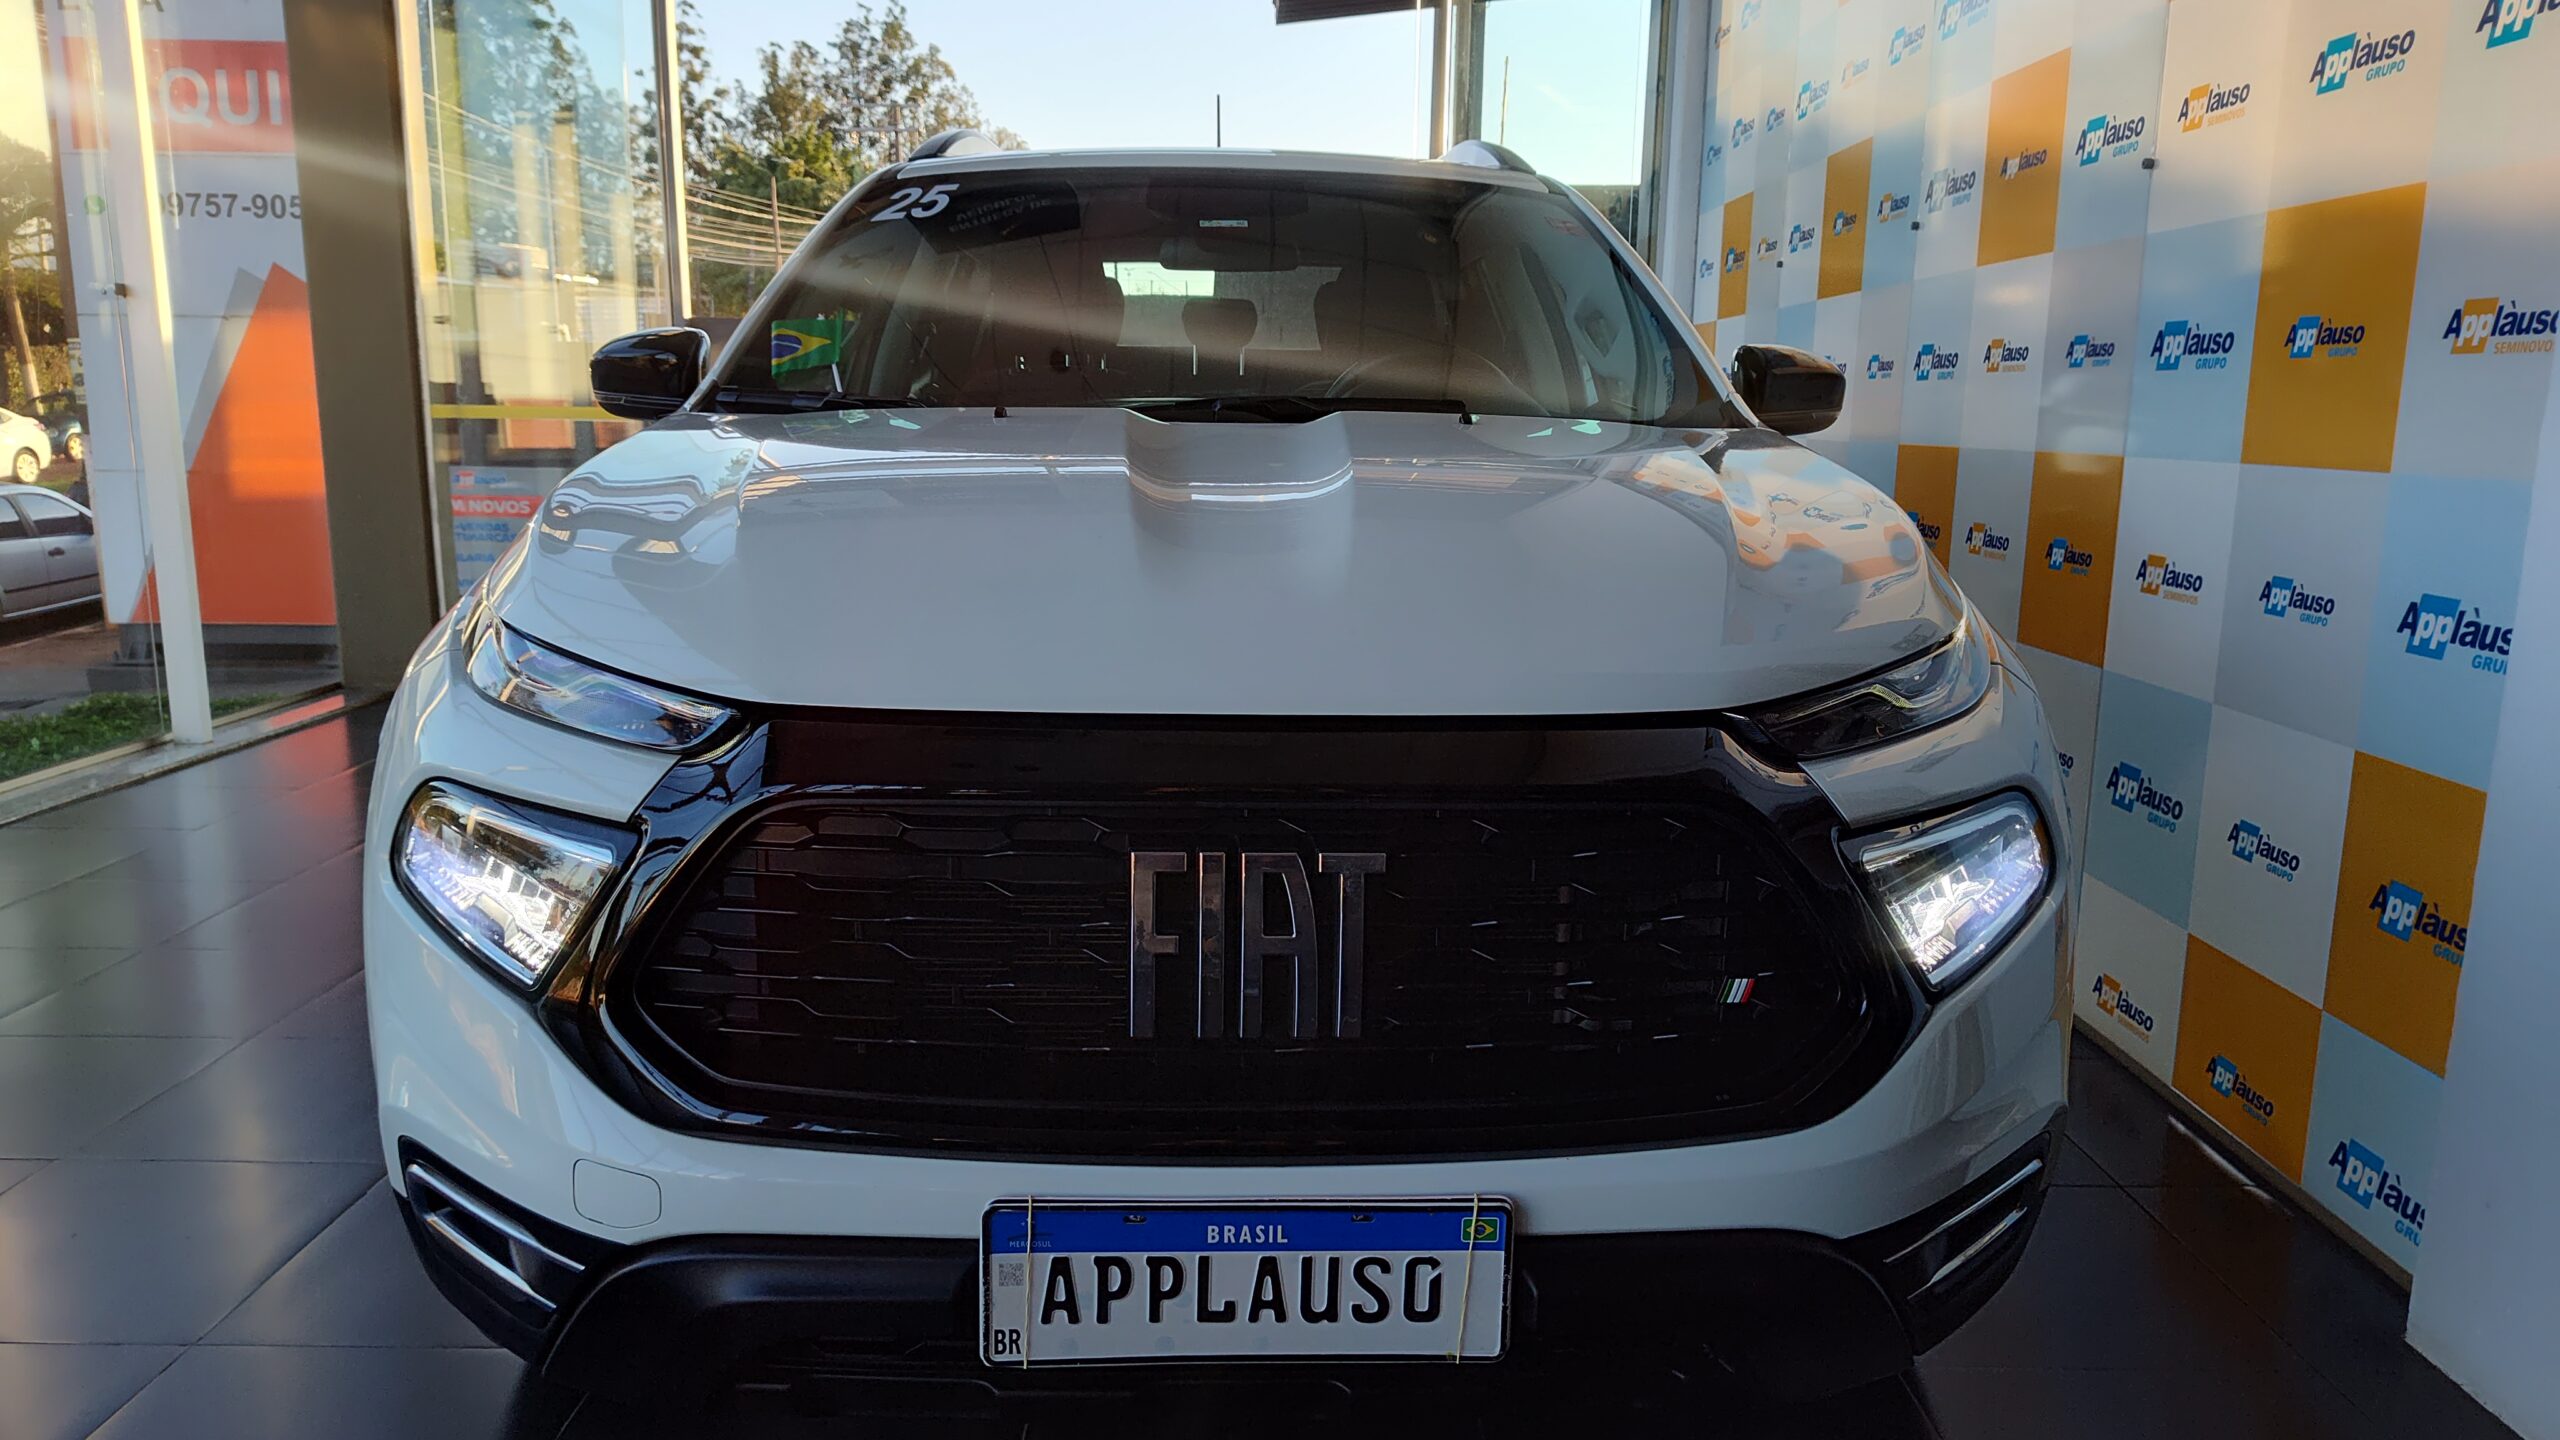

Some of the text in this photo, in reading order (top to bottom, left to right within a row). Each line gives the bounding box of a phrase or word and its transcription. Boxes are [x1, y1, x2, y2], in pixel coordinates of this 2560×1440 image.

[2309, 30, 2415, 87] Applàuso
[2365, 59, 2405, 82] GRUPO
[150, 67, 283, 128] QUI
[2112, 141, 2139, 158] GRUPO
[160, 192, 302, 220] 9757-905
[869, 183, 960, 222] 25
[2150, 323, 2234, 364] Applàuso
[2493, 340, 2555, 354] SEMINOVO
[2195, 357, 2227, 370] GRUPO
[2259, 580, 2335, 616] Applàuso
[2299, 613, 2328, 627] GRUPO
[2397, 602, 2514, 656] Applàus
[2471, 654, 2507, 676] GRU
[2106, 766, 2183, 821] Applàuso
[2147, 812, 2177, 834] GRUPO
[2227, 823, 2300, 872] Applàuso
[2265, 863, 2294, 883] GRUPO
[2369, 884, 2468, 952] Applàus
[1129, 851, 1388, 1038] FIAT
[2433, 943, 2463, 968] GRU
[1206, 1225, 1289, 1244] BRASIL
[1040, 1255, 1443, 1325] APPLAUSO
[994, 1328, 1022, 1355] BR
